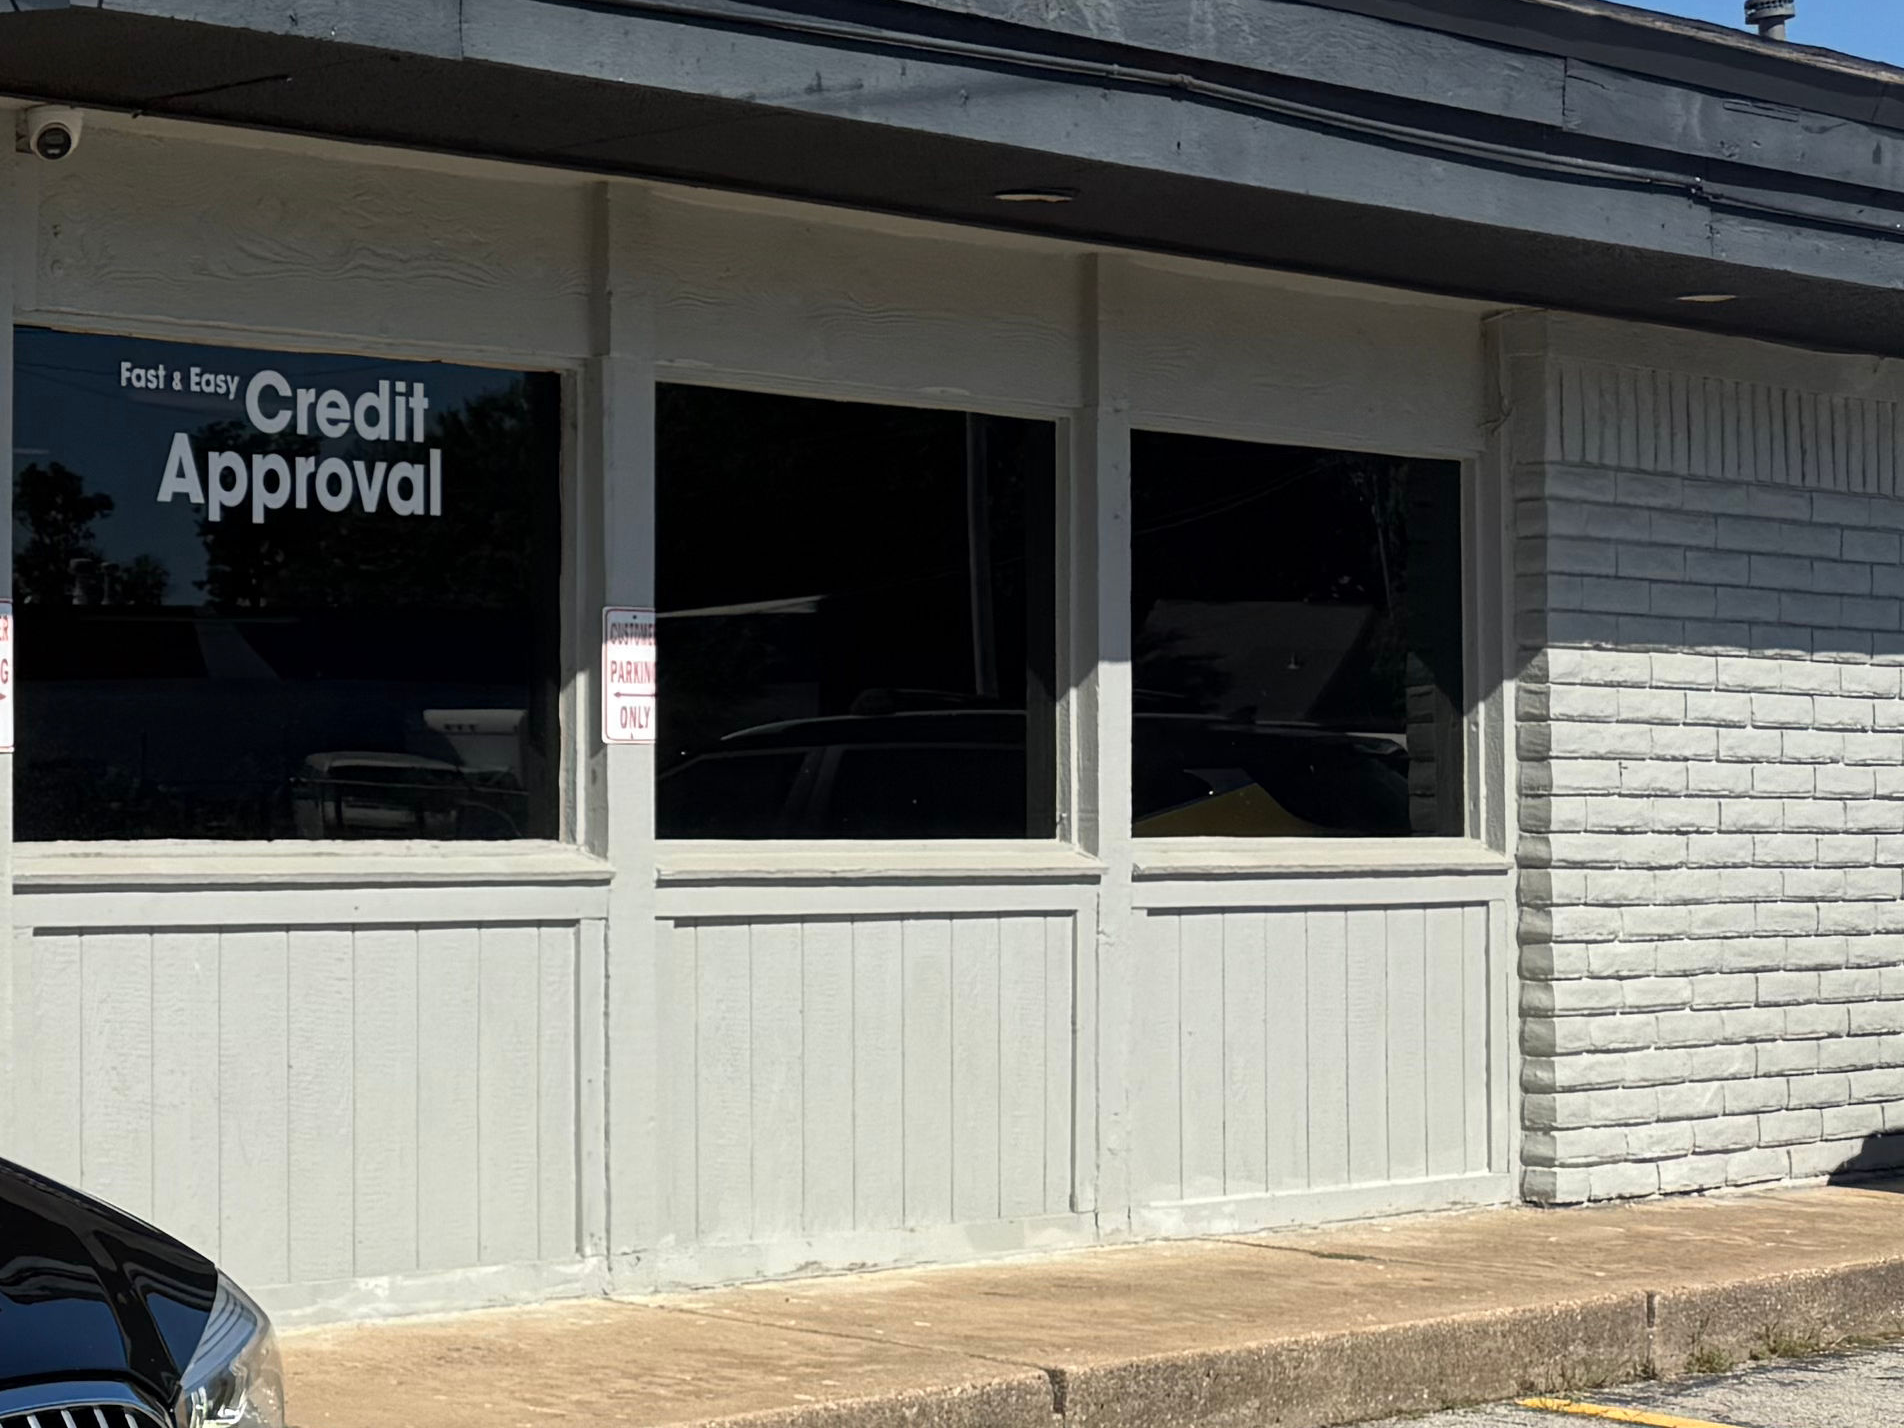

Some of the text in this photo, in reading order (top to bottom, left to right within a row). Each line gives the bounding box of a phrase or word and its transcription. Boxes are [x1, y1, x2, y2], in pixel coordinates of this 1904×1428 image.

[120, 361, 429, 443] Fast & Easy Credit
[156, 432, 442, 524] Approval
[611, 622, 656, 645] CUSTOME
[610, 660, 656, 684] PARKIN
[620, 705, 651, 729] ONLY
